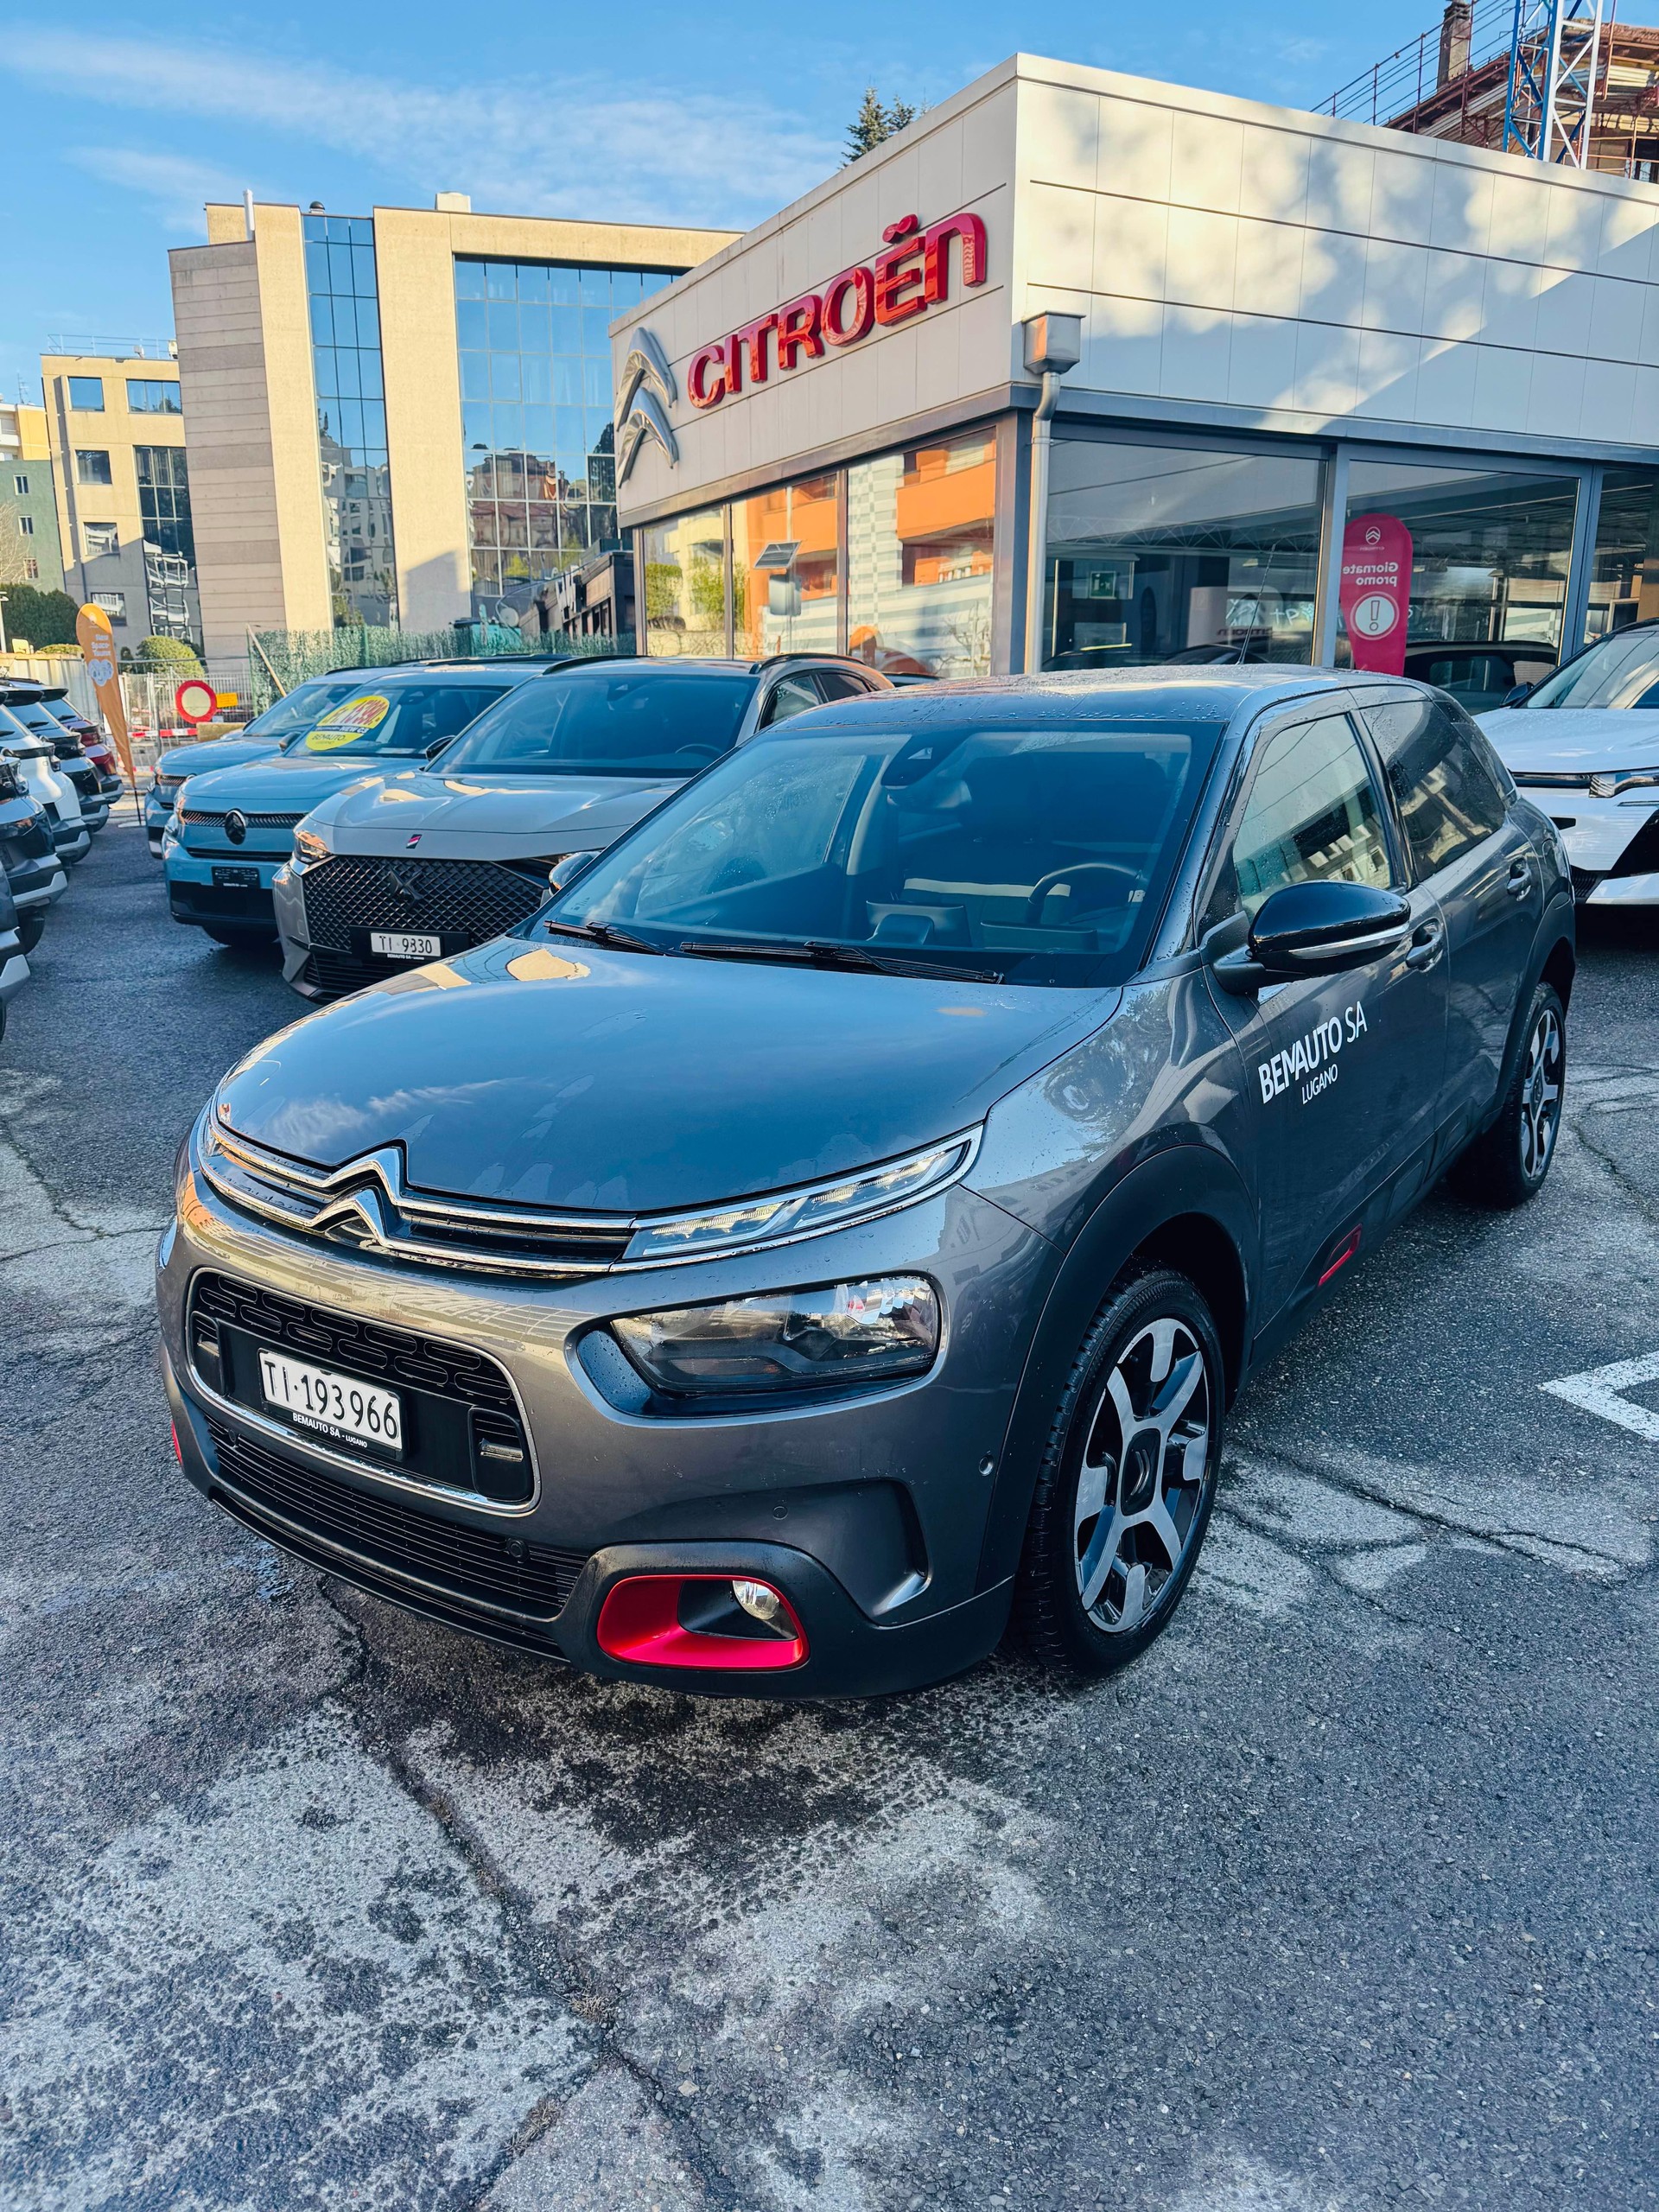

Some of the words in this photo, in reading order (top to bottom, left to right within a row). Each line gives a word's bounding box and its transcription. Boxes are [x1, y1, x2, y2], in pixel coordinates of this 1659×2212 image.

[688, 213, 987, 410] CITROËN
[1258, 1016, 1343, 1104] BEMAUTO
[1344, 1001, 1368, 1043] SA
[1301, 1064, 1338, 1104] LUGANO
[293, 1412, 328, 1433] BEMAUTO
[329, 1427, 340, 1439] SA
[346, 1434, 368, 1448] LUGANO
